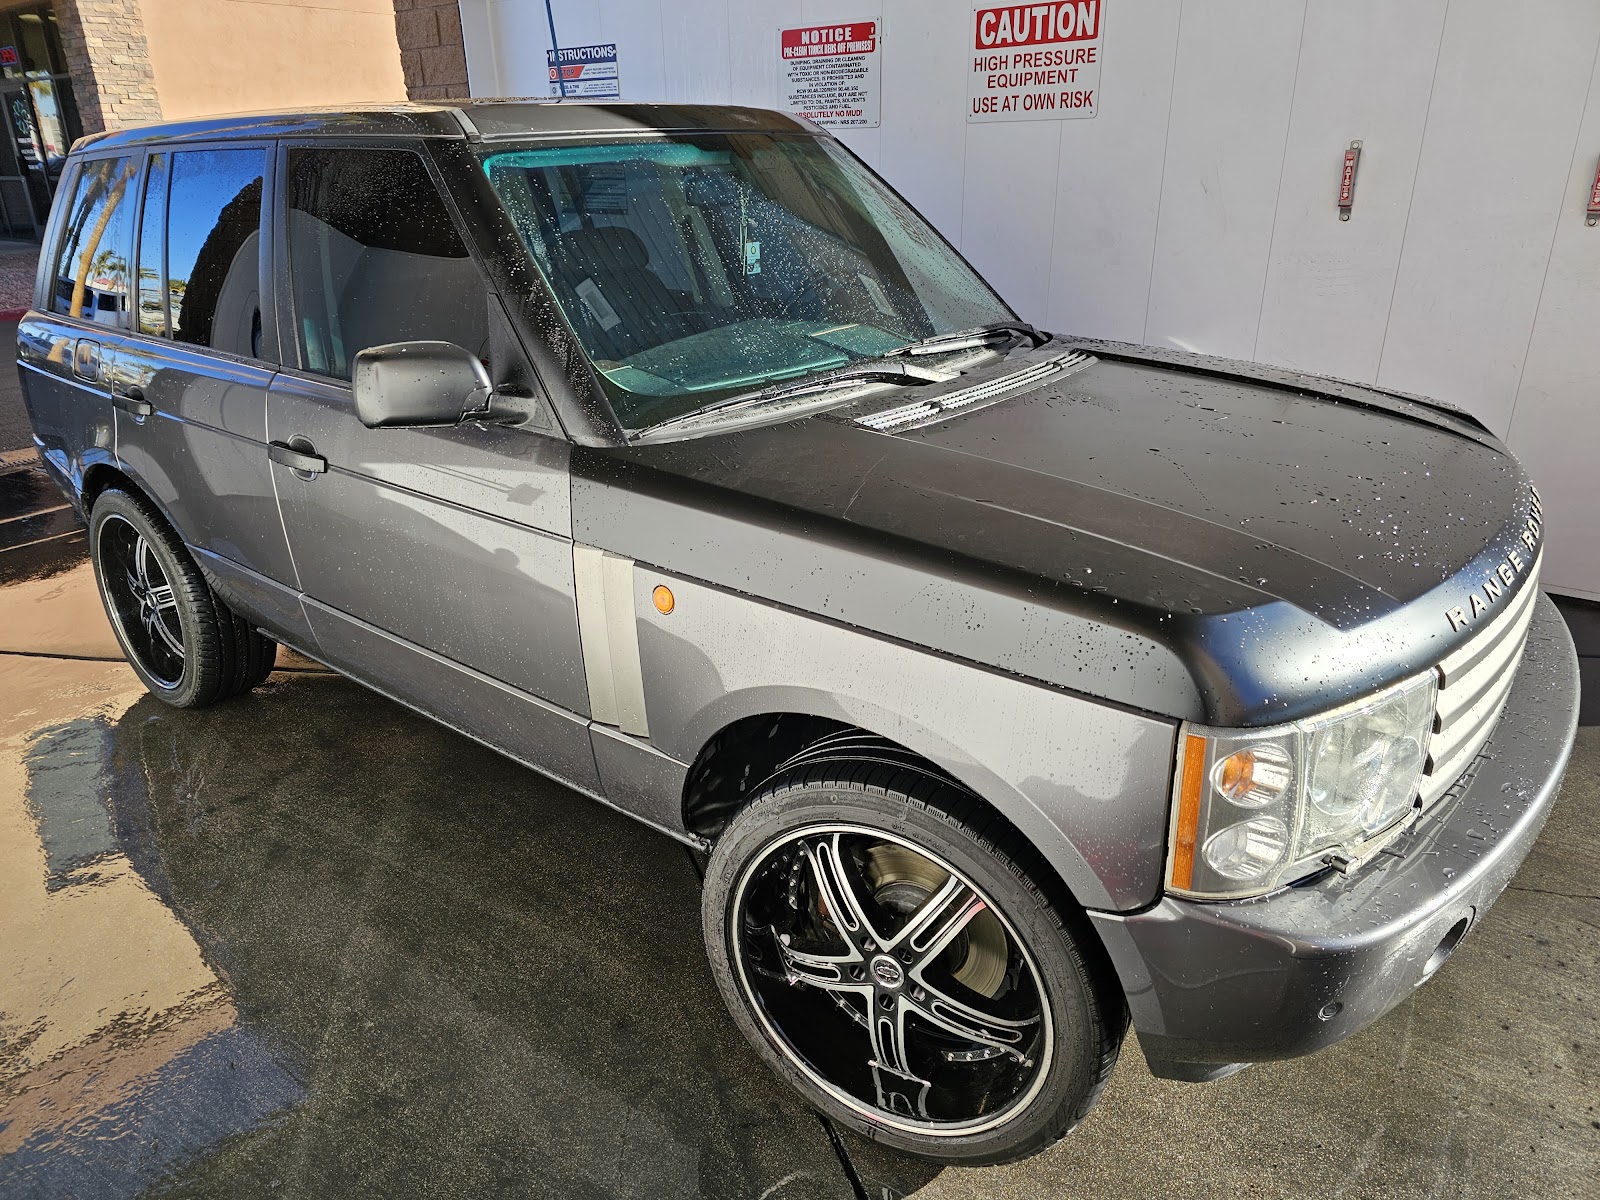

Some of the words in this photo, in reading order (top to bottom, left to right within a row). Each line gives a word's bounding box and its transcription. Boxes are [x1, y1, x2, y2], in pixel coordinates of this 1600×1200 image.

[980, 0, 1097, 46] CAUTION
[802, 27, 852, 44] NOTICE
[784, 46, 808, 58] PRE-CLEAN
[808, 44, 824, 55] TRUCK
[824, 43, 836, 54] BEDS
[837, 42, 847, 53] OFF
[847, 40, 872, 52] PREMISES!
[974, 55, 1008, 72] HIGH
[1014, 48, 1097, 69] PRESSURE
[988, 68, 1078, 88] EQUIPMENT
[973, 96, 998, 114] USE
[1002, 95, 1020, 112] AT
[1023, 92, 1056, 111] OWN
[1060, 90, 1094, 109] RISK
[1344, 160, 1353, 186] MATS
[1445, 550, 1524, 632] RANGE
[1521, 484, 1543, 552] ROVER
